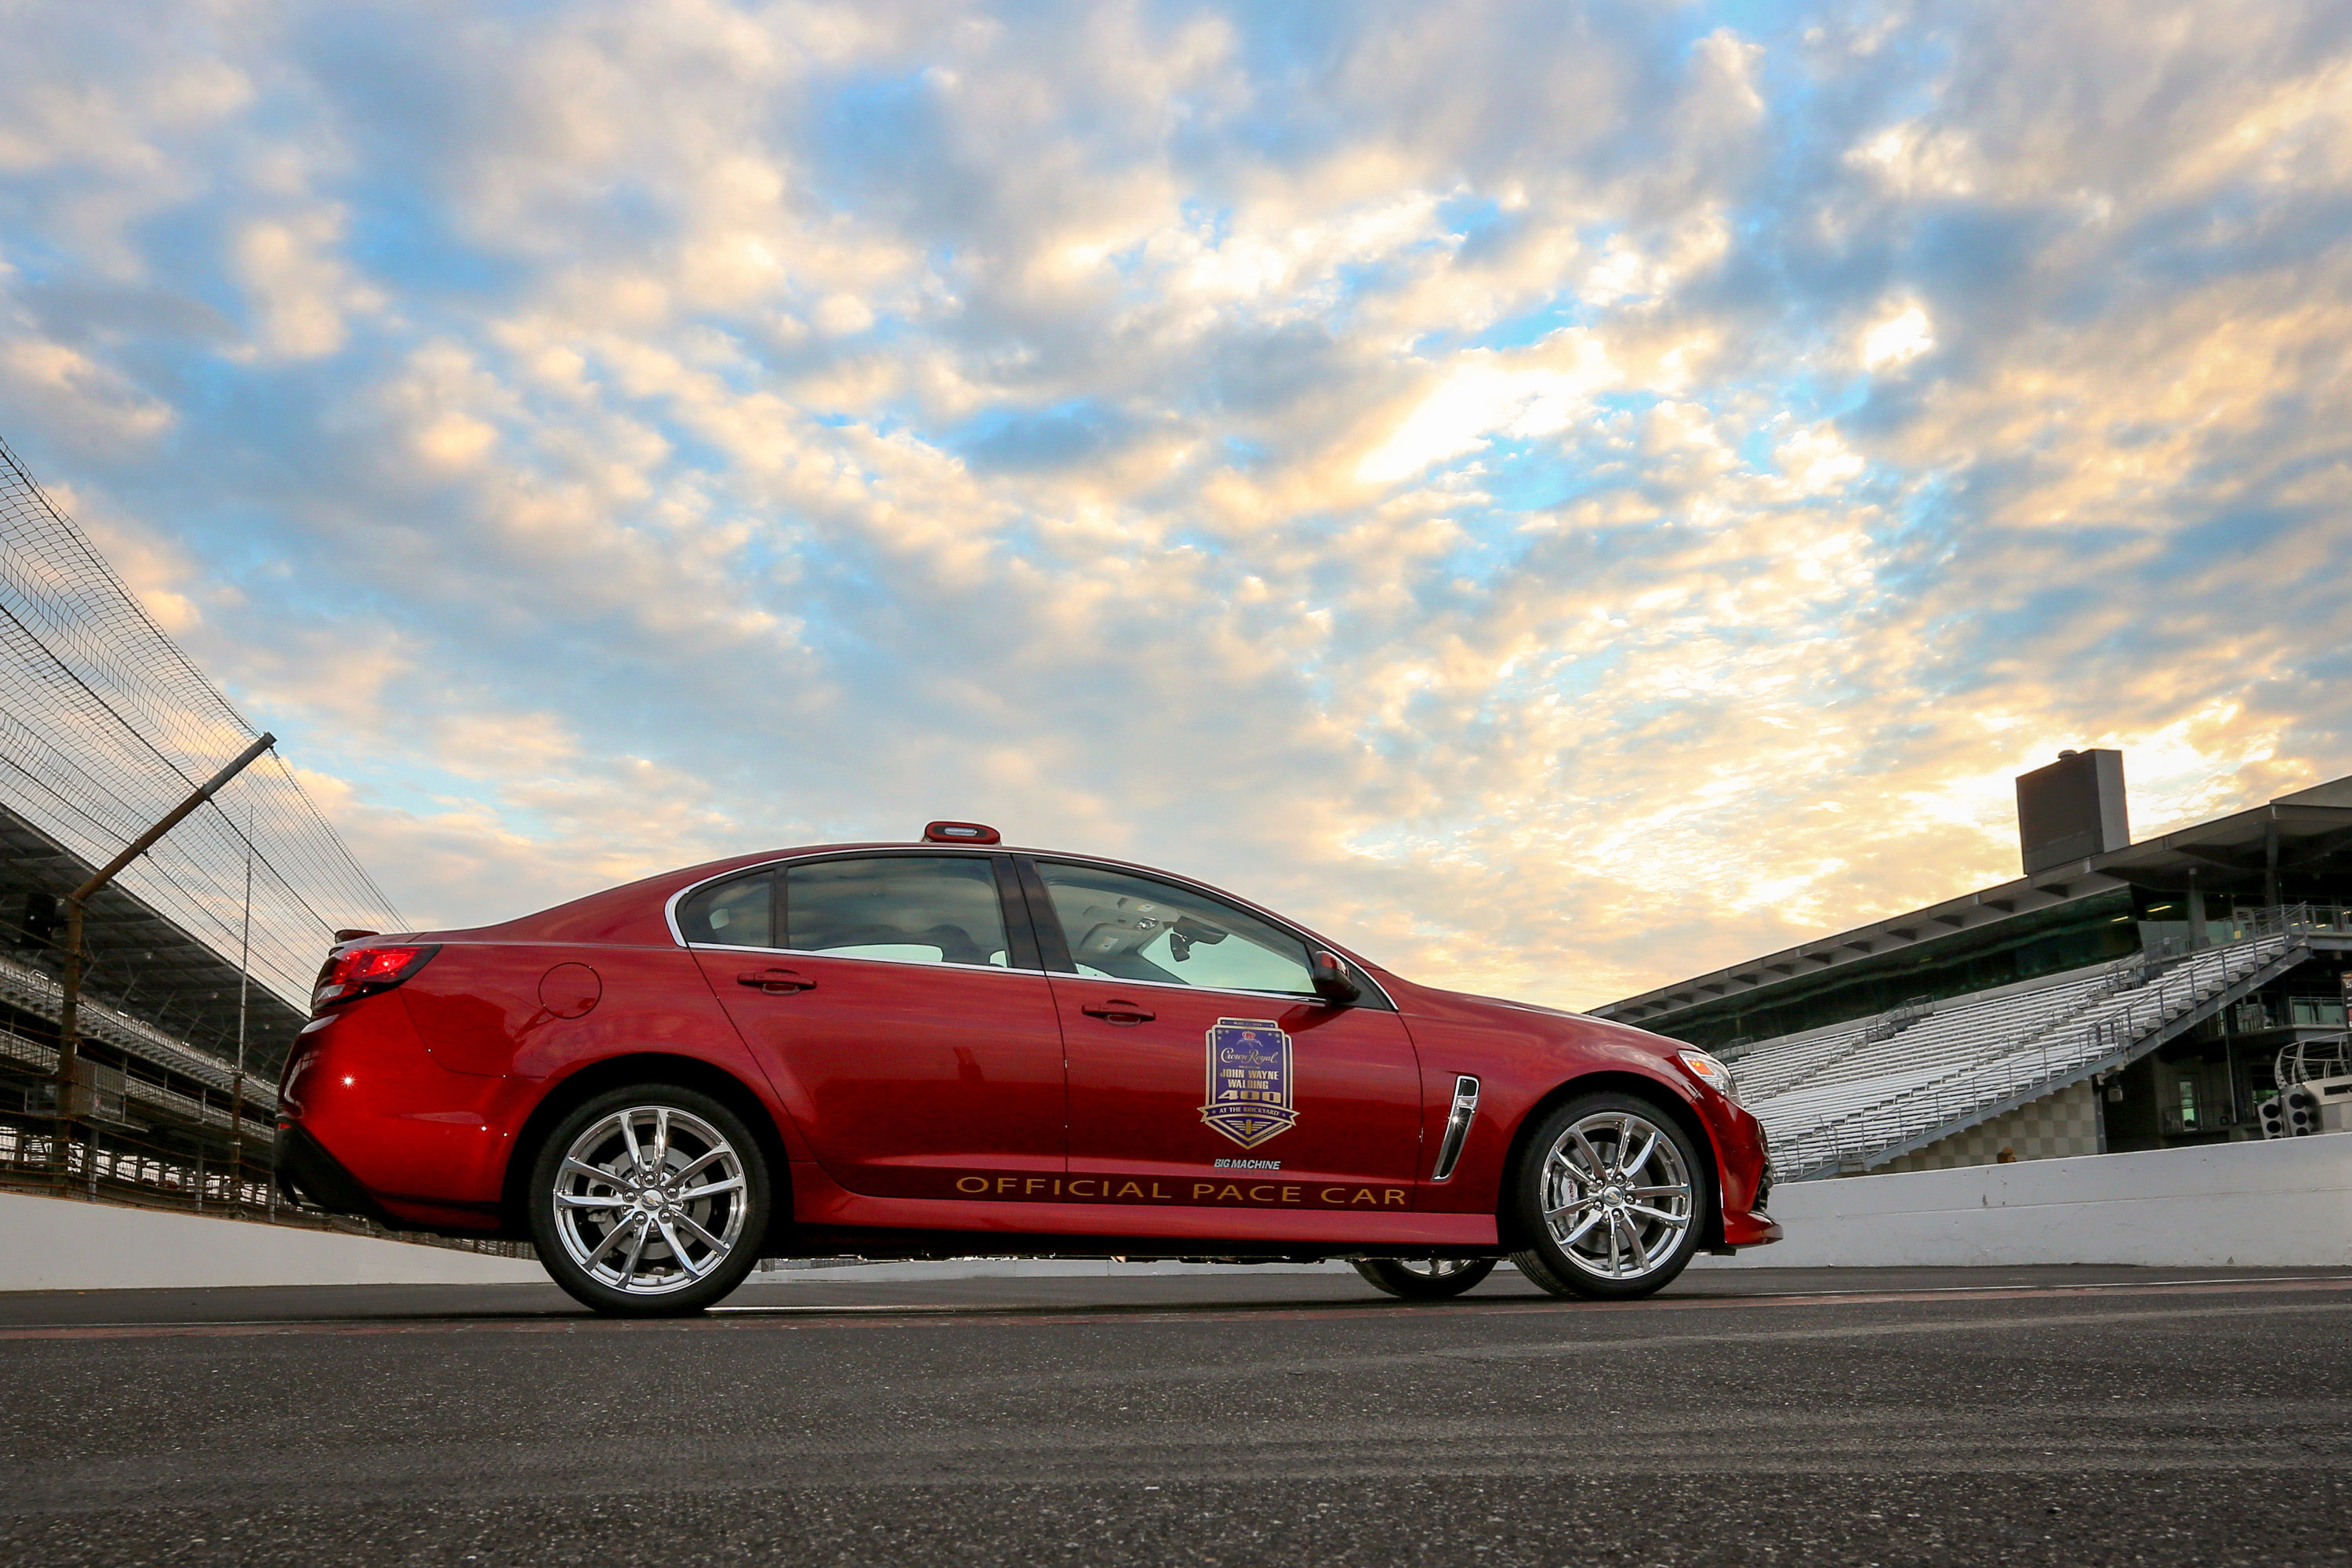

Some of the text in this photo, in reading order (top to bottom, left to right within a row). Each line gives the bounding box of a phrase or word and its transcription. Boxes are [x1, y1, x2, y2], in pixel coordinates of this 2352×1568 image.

[1221, 1047, 1279, 1065] Crown Royal
[1220, 1069, 1279, 1080] JOHN WAYNE
[1228, 1079, 1269, 1089] WALDING
[1218, 1090, 1281, 1103] 400
[1243, 1107, 1279, 1116] BRICKYARD
[1214, 1159, 1281, 1170] BIG MACHINE
[956, 1177, 1406, 1205] OFFICIAL PACE CAR
